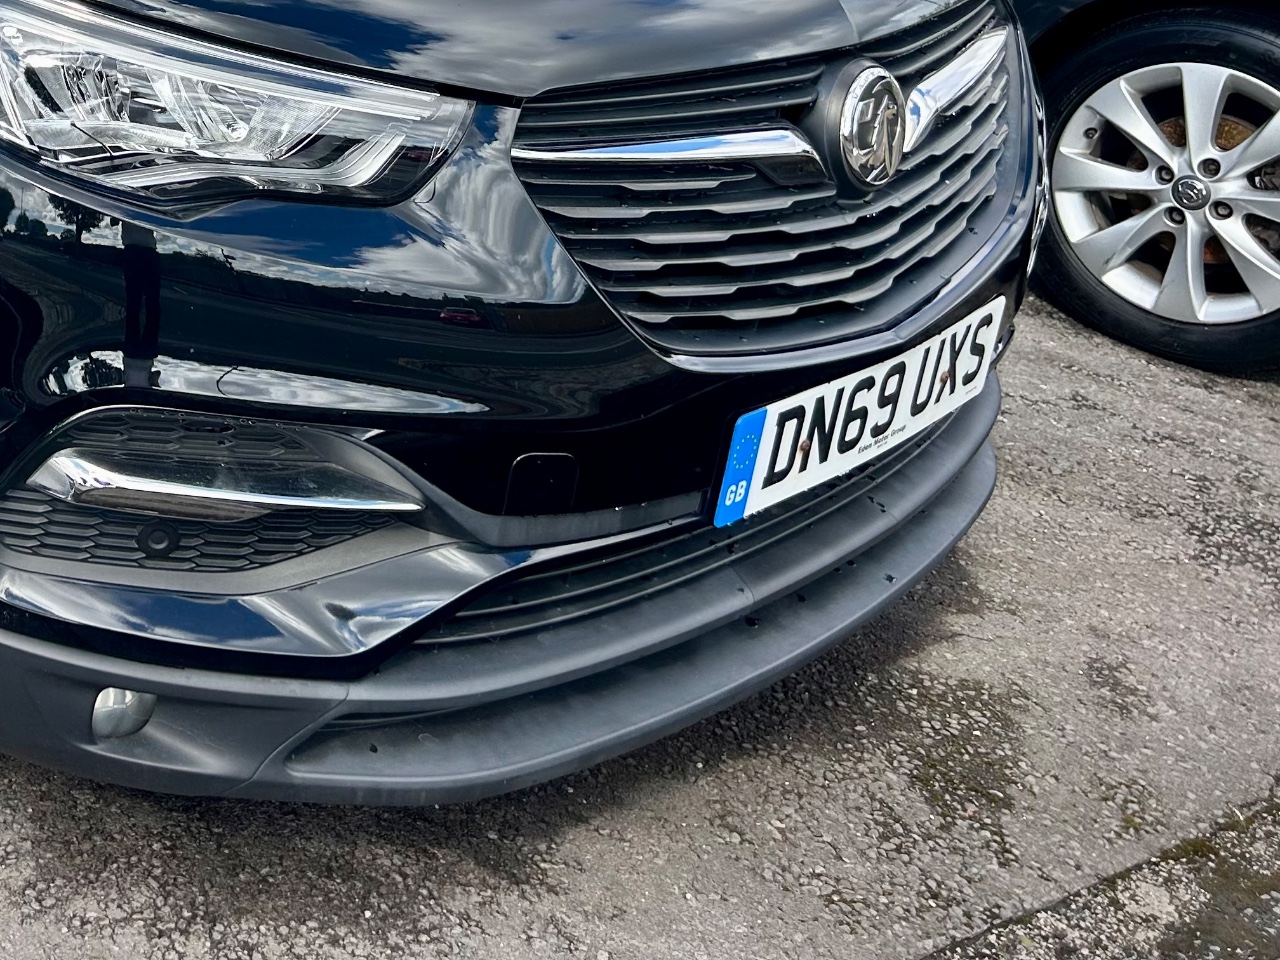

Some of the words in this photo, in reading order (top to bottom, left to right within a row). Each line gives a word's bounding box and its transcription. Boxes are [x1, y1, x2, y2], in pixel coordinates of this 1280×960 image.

[725, 480, 747, 507] GB
[761, 360, 907, 490] DN69
[909, 312, 993, 418] UXS
